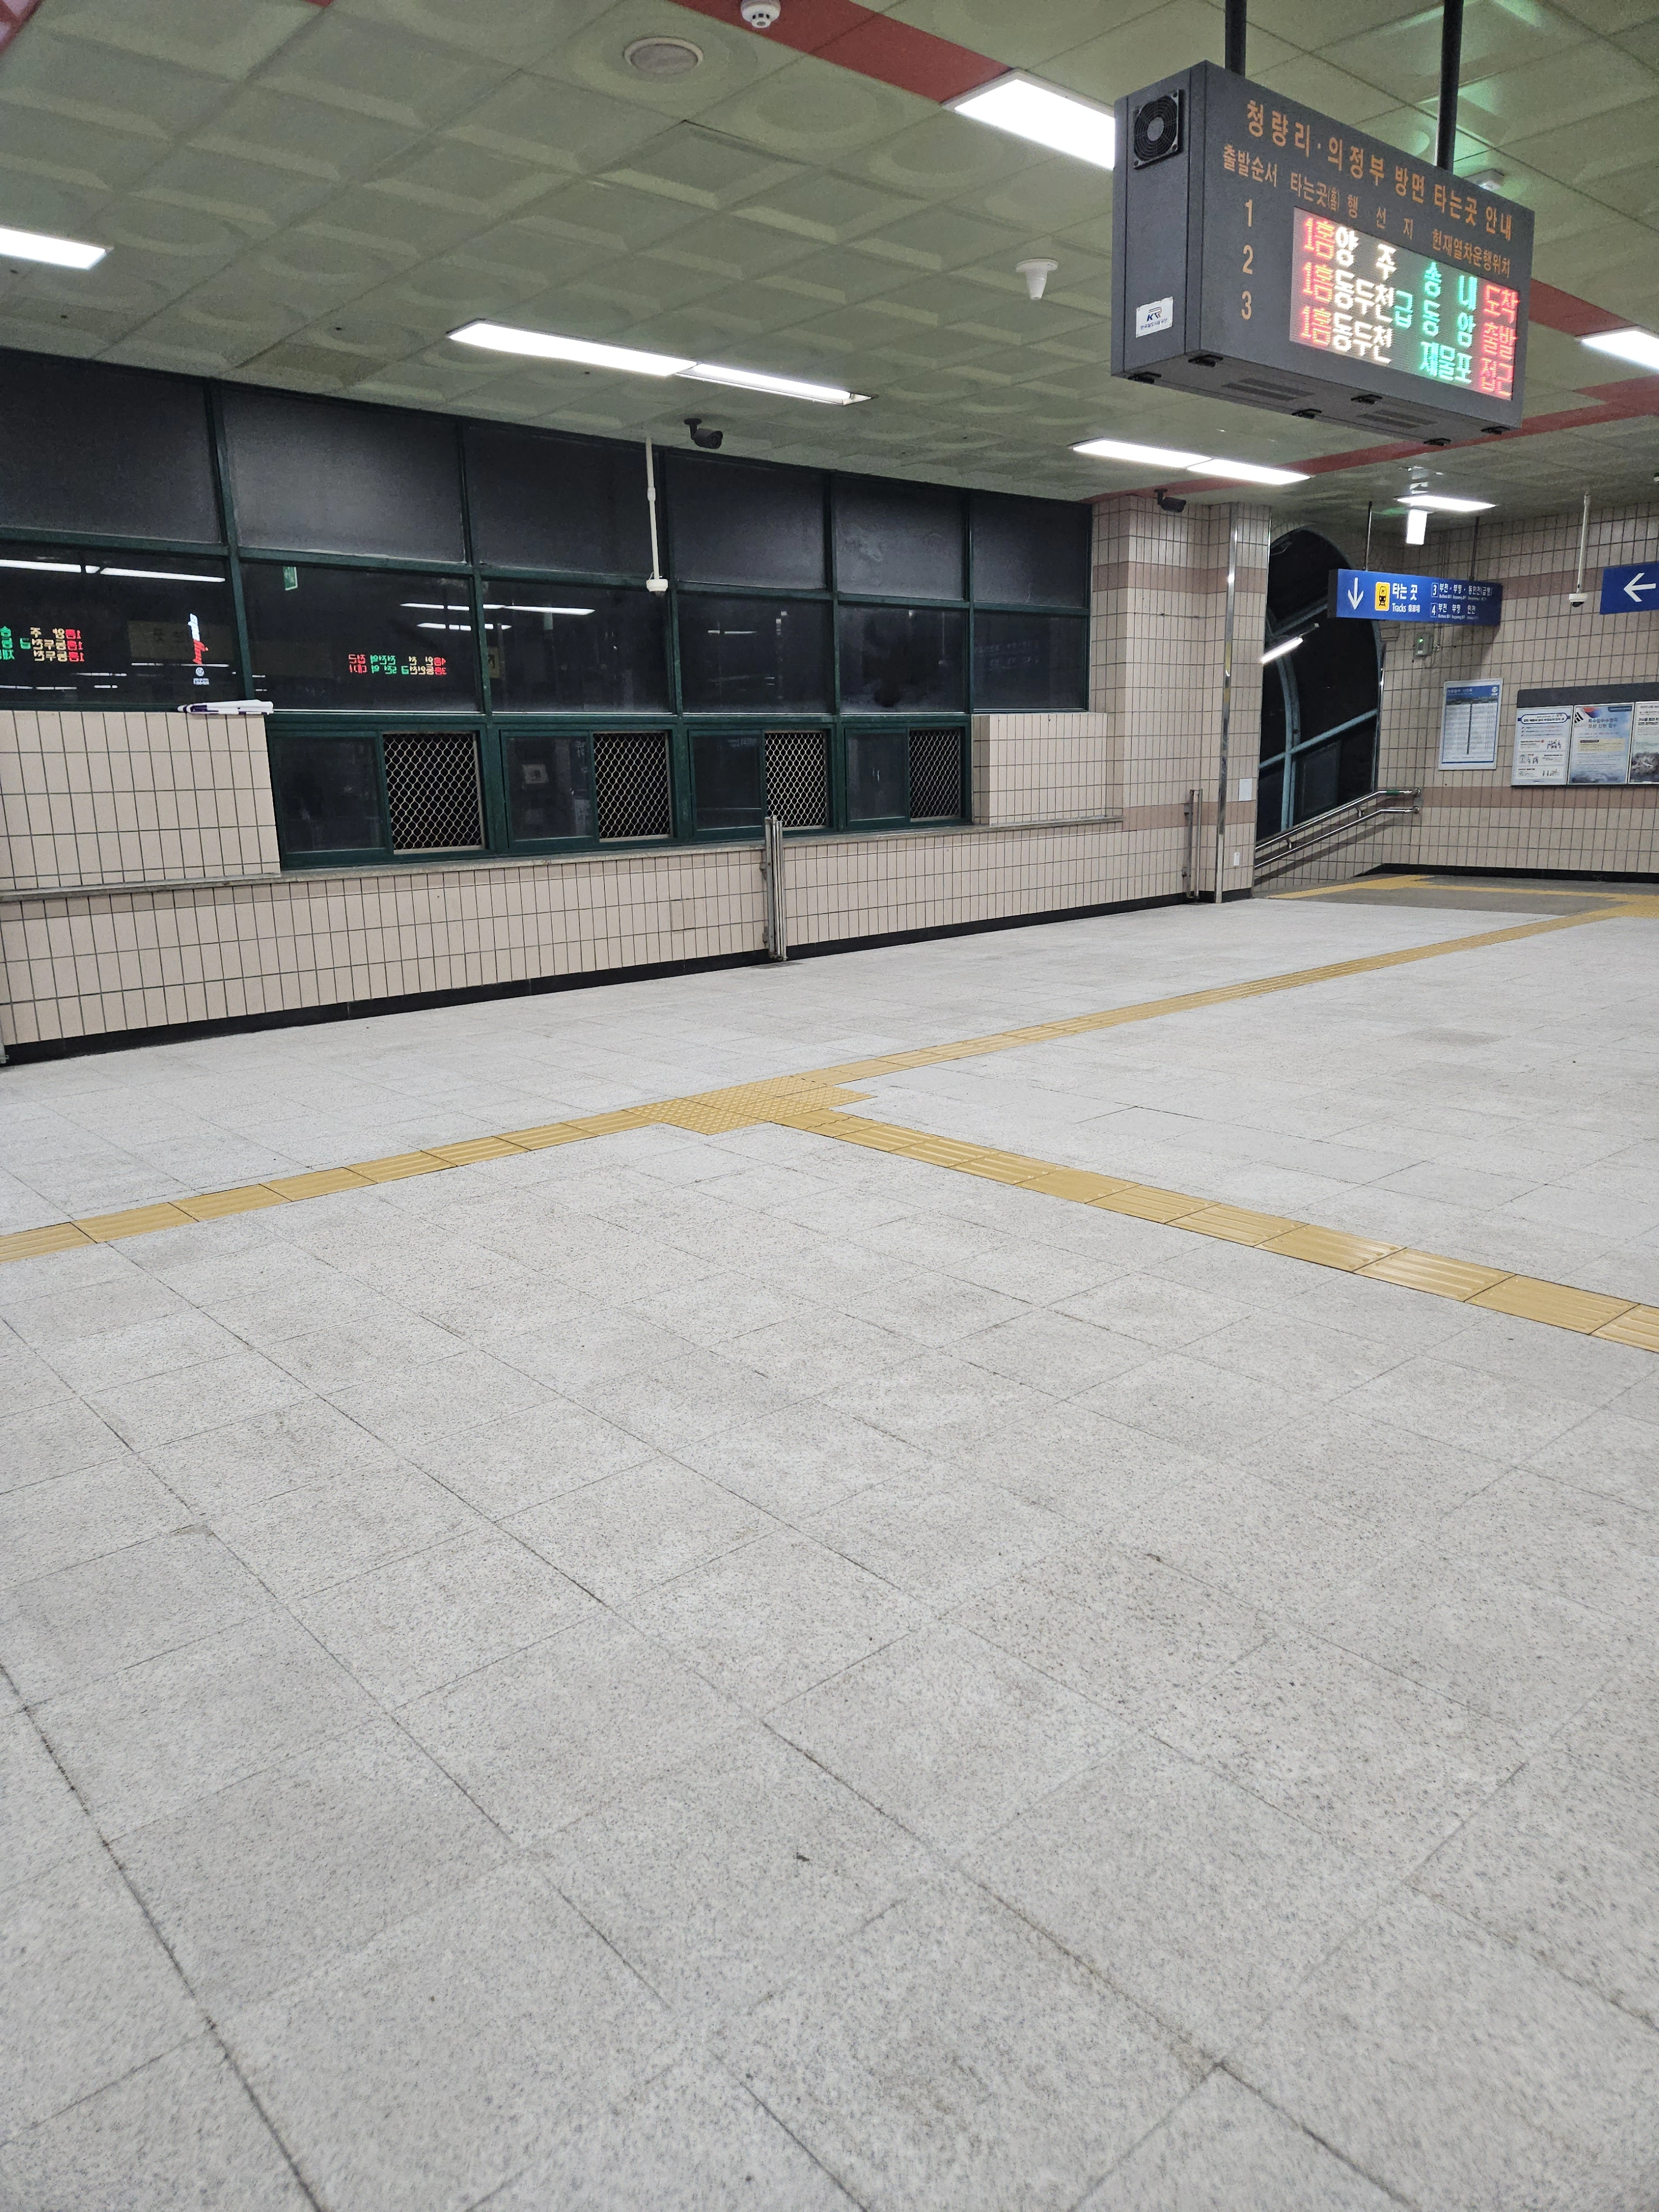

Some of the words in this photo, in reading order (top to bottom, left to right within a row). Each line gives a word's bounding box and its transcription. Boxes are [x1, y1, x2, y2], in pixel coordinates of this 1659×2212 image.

[1223, 143, 1277, 187] 출발순서
[1432, 228, 1510, 278] 현재열차운행위치
[1245, 199, 1253, 227] 1
[1395, 166, 1425, 204] 방면
[1434, 184, 1478, 226] 타는곳
[1486, 206, 1512, 241] 안내
[1243, 246, 1253, 275] 2
[1303, 217, 1335, 260] 1홈
[1484, 284, 1520, 324] 도착
[1241, 291, 1252, 320] 3
[1302, 262, 1334, 303] 1홈
[1334, 269, 1395, 323] 동두천
[1483, 322, 1517, 360] 출발
[1301, 306, 1332, 346] 1홈
[1333, 312, 1393, 364] 동두천
[1420, 341, 1472, 384] 제물포
[1481, 357, 1514, 396] 접근
[1432, 584, 1437, 596] 3
[1392, 602, 1406, 612] Tracks
[1431, 604, 1436, 615] 4
